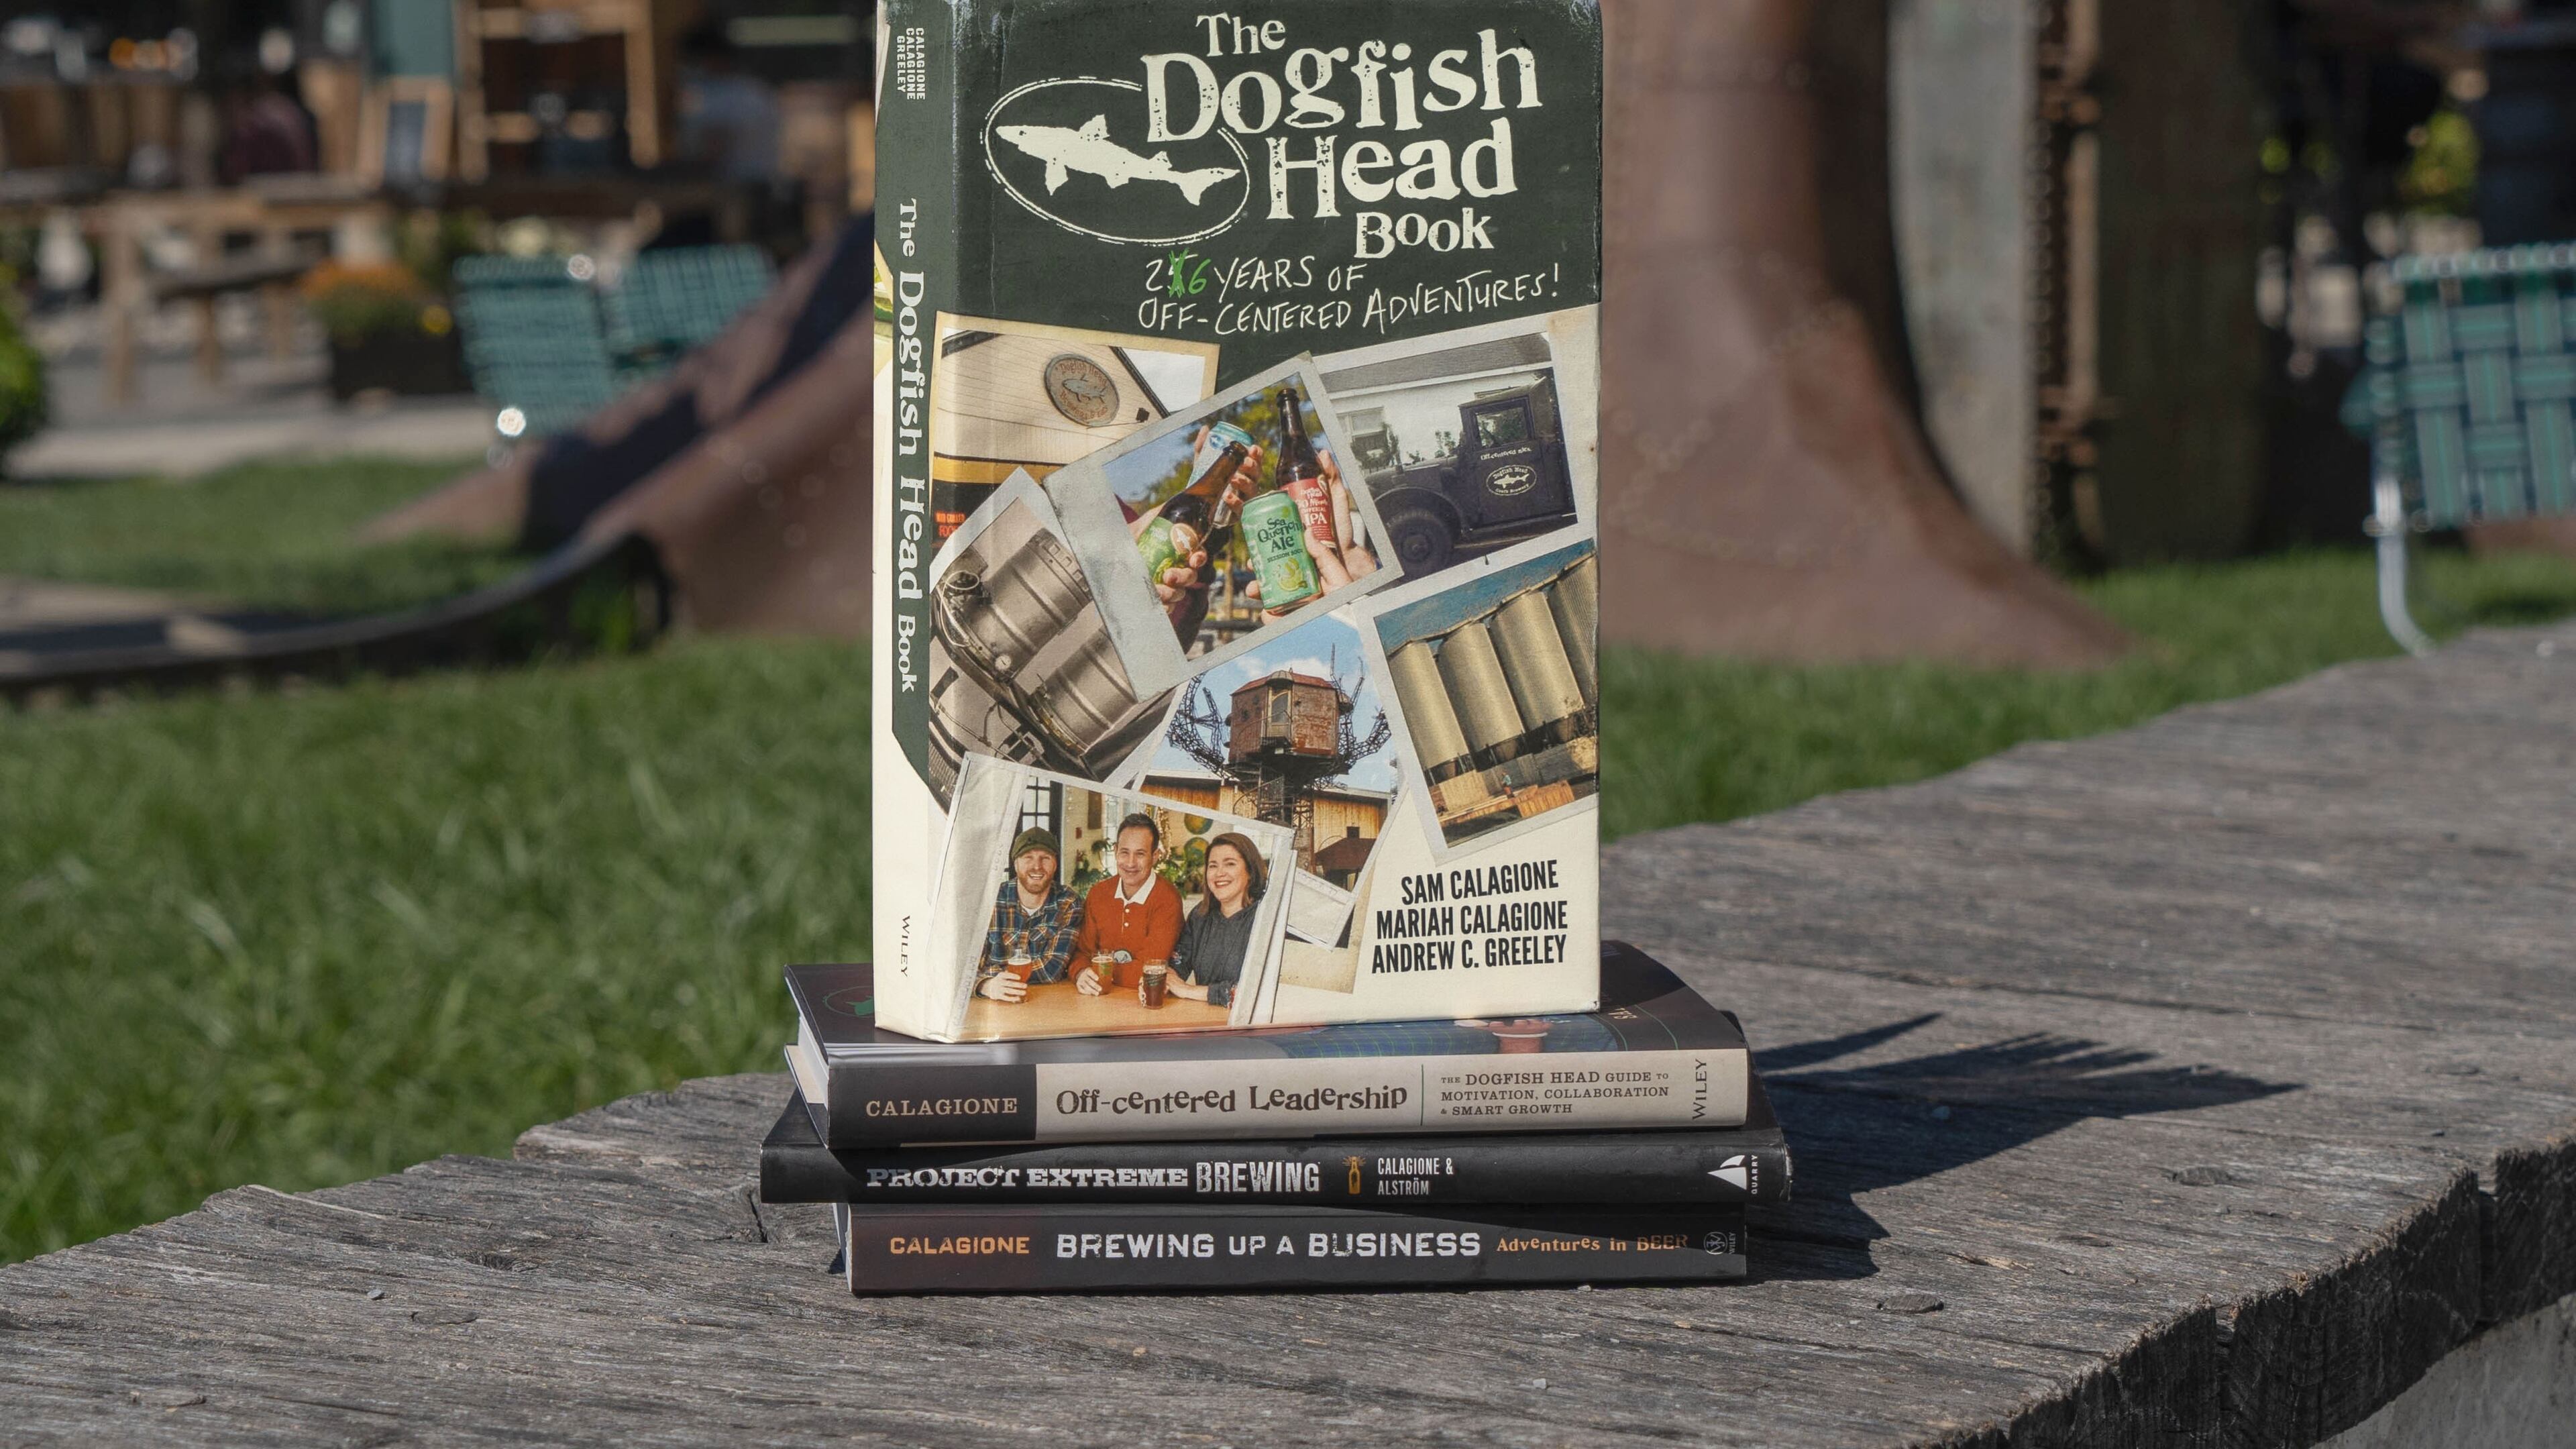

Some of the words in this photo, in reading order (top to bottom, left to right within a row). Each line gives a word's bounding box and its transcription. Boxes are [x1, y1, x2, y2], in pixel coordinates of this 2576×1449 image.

[1196, 13, 1286, 57] The
[897, 36, 906, 93] GREELEY
[906, 28, 916, 100] CALAGIONE
[916, 28, 925, 99] CALAGIONE
[1140, 29, 1542, 142] Dogfish
[1266, 117, 1517, 220] Head
[900, 198, 917, 257] The
[1138, 298, 1350, 335] OFF-CENTERED
[1362, 263, 1560, 334] ADVENTURES!
[1214, 256, 1316, 303] YEARS
[1328, 264, 1368, 291] OF
[899, 271, 926, 456] Dogfish
[898, 475, 925, 599] Head
[1257, 521, 1301, 543] Quench
[1267, 518, 1285, 530] Sea
[1304, 512, 1328, 526] IPA
[1271, 535, 1295, 553] Ale
[1401, 873, 1444, 905] SAM
[1450, 859, 1558, 900] CALAGIONE
[1377, 906, 1454, 939] MARIAH
[1460, 900, 1568, 934] CALAGIONE
[901, 915, 910, 977] WILEY
[1372, 941, 1455, 973] ANDREW
[1462, 939, 1479, 968] C.
[1485, 934, 1566, 967] GREELEY
[1441, 1089, 1538, 1102] MOTIVATION,
[1544, 1087, 1669, 1099] COLLABORATION
[1465, 1073, 1544, 1086] DOGFISH
[1550, 1071, 1601, 1083] HEAD
[1605, 1072, 1652, 1083] GUIDE
[1692, 1058, 1707, 1120] WILEY
[865, 1097, 1018, 1117] CALAGIONE
[1056, 1089, 1236, 1116] Off-centered
[1250, 1085, 1408, 1111] Leadership
[1452, 1105, 1503, 1116] SMART
[1508, 1104, 1573, 1114] GROWTH
[867, 1168, 1019, 1189] PROJECT
[1026, 1168, 1189, 1188] EXTREME
[1195, 1161, 1321, 1194] BREWING
[1377, 1157, 1441, 1175] CALAGIONE
[1445, 1158, 1454, 1175] &
[1377, 1177, 1431, 1196] ALSTRÖM
[890, 1236, 1030, 1254] CALAGIONE
[1057, 1233, 1214, 1258] BREWING
[1228, 1236, 1267, 1256] UP
[1275, 1236, 1295, 1254] A
[1309, 1232, 1481, 1257] BUSINESS
[1497, 1236, 1601, 1252] Adventures
[1609, 1238, 1626, 1251] in
[1637, 1234, 1688, 1250] BEER
